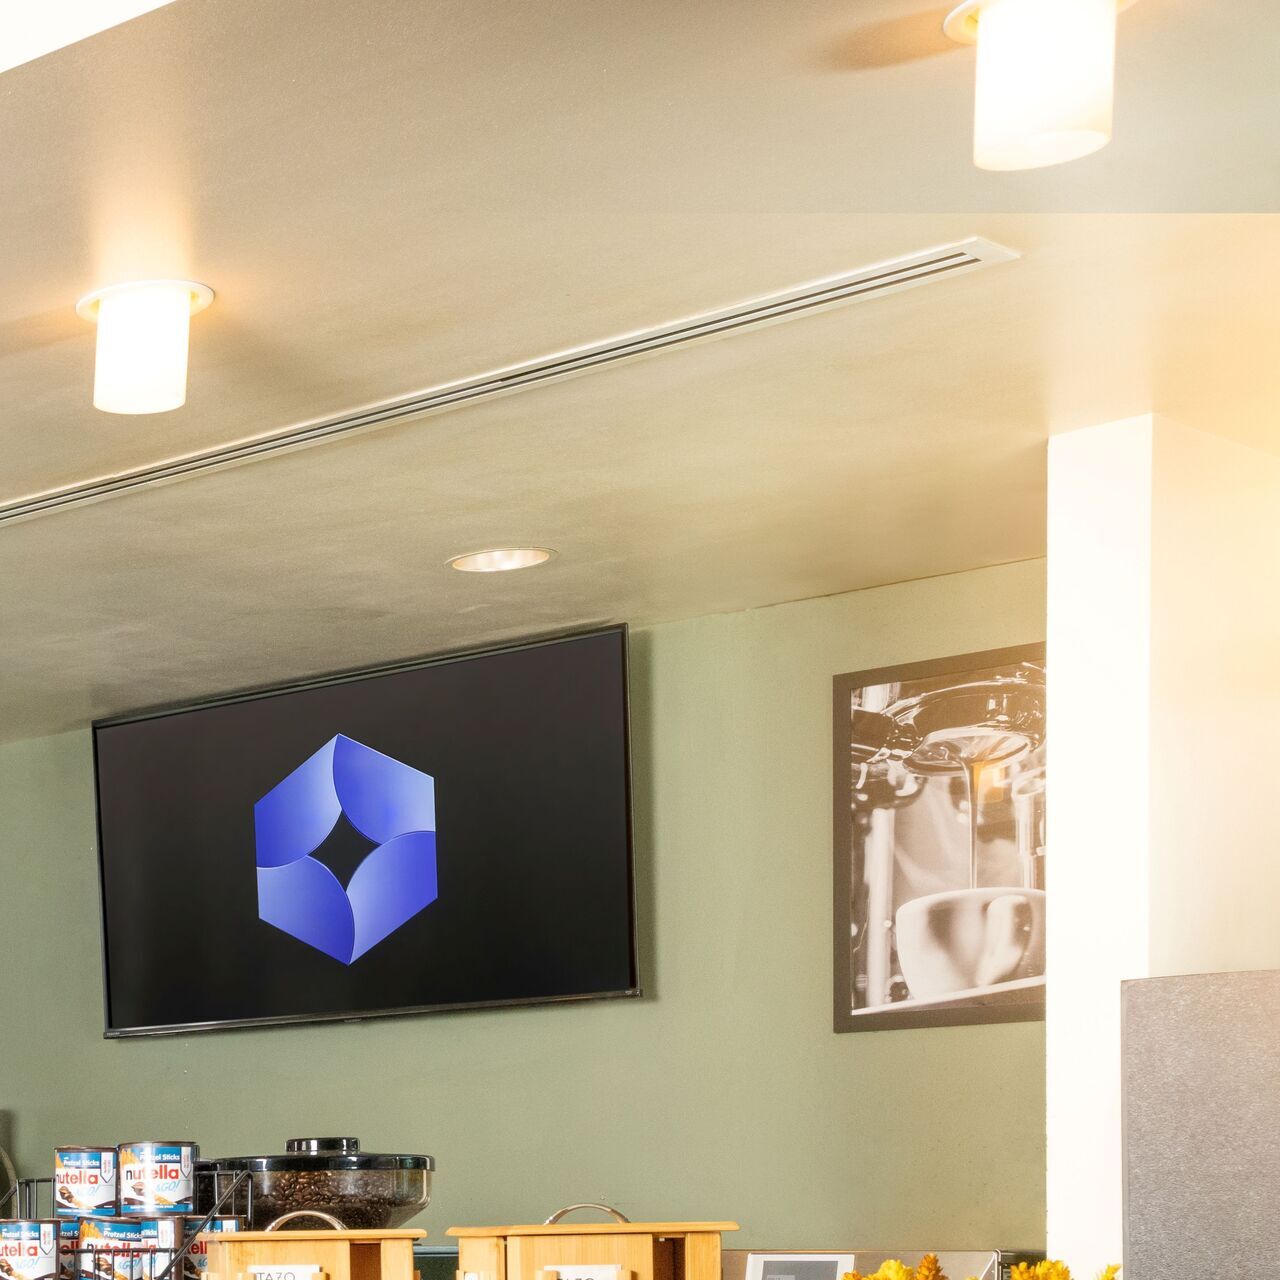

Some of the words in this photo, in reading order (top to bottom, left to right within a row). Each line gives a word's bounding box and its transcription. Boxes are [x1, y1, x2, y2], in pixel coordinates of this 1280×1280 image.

[164, 1153, 180, 1161] Sticks
[56, 1168, 98, 1185] nutella
[126, 1165, 179, 1181] nutella
[103, 1230, 124, 1239] Pretzel
